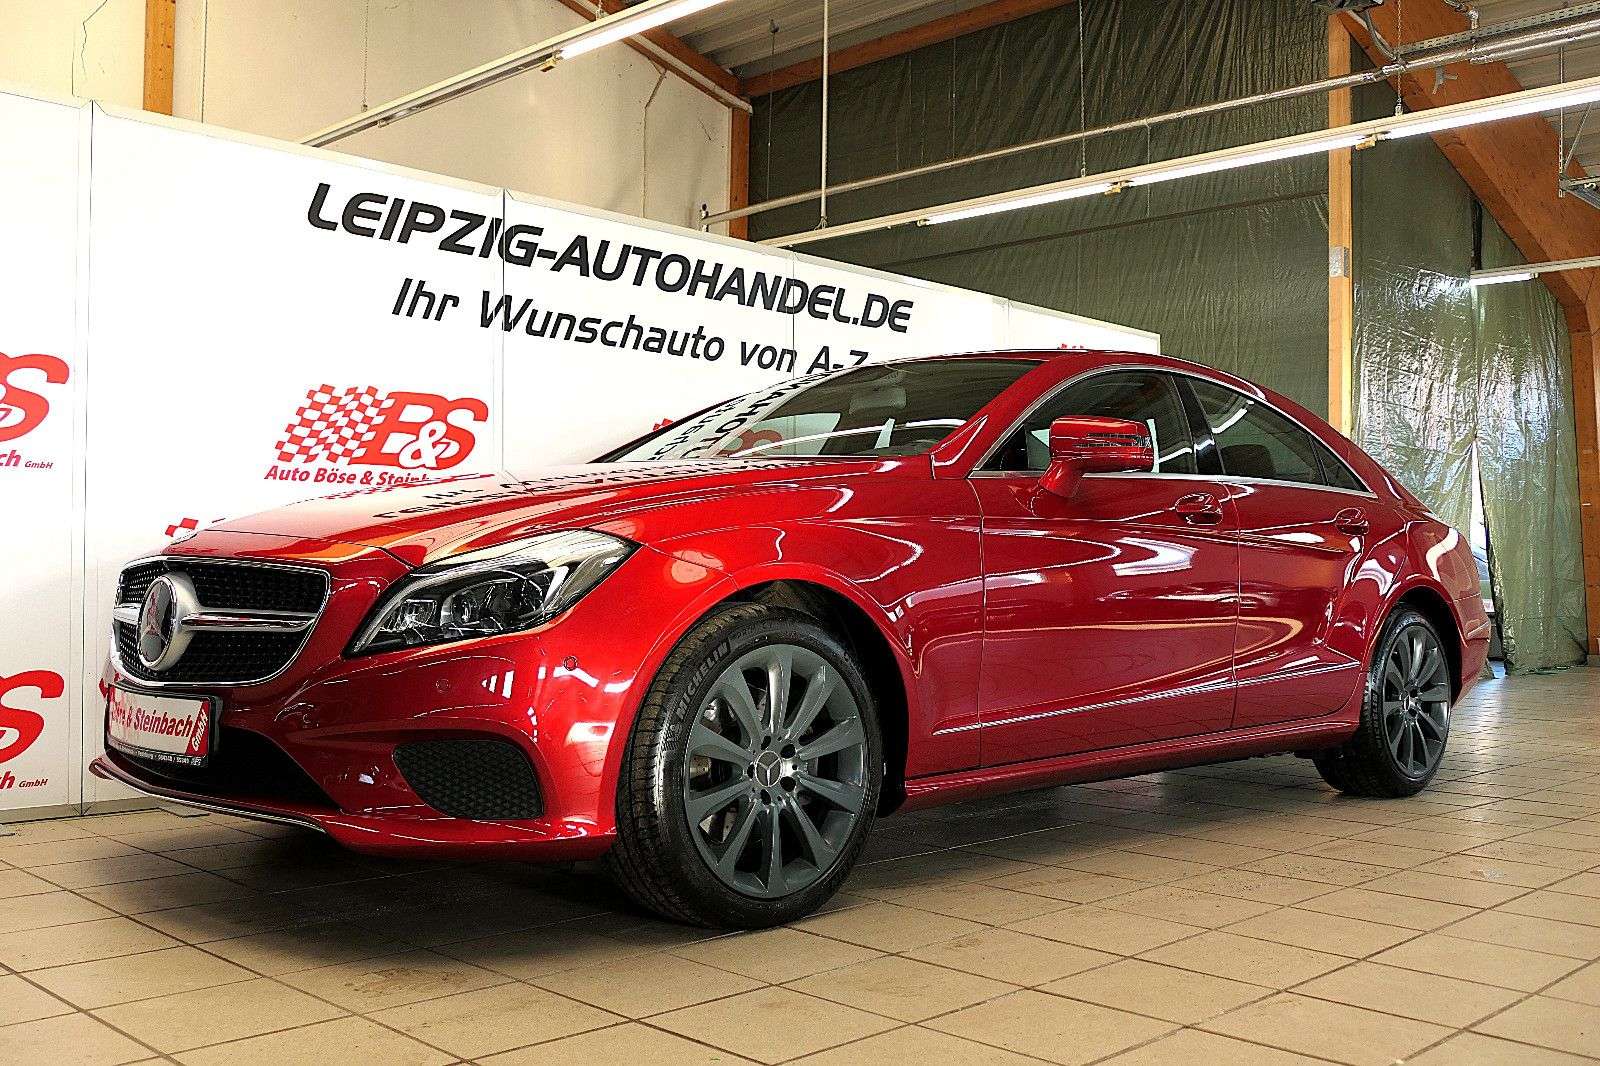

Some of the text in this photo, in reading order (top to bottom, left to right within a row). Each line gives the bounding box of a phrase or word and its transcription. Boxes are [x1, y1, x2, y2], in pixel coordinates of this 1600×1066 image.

[308, 183, 913, 333] LEIPZIG-AUTOHANDEL.DE
[392, 278, 459, 321] Ihr
[480, 291, 724, 361] Wunschauto
[741, 342, 797, 372] von
[348, 391, 489, 470] B&S
[24, 460, 54, 470] GmbH
[264, 465, 311, 482] Auto
[314, 467, 357, 485] Böse
[360, 471, 373, 486] &
[676, 641, 730, 720] MICHELIN
[134, 708, 193, 738] Steinbach
[192, 709, 209, 752] GmbH
[19, 778, 49, 788] GmbH
